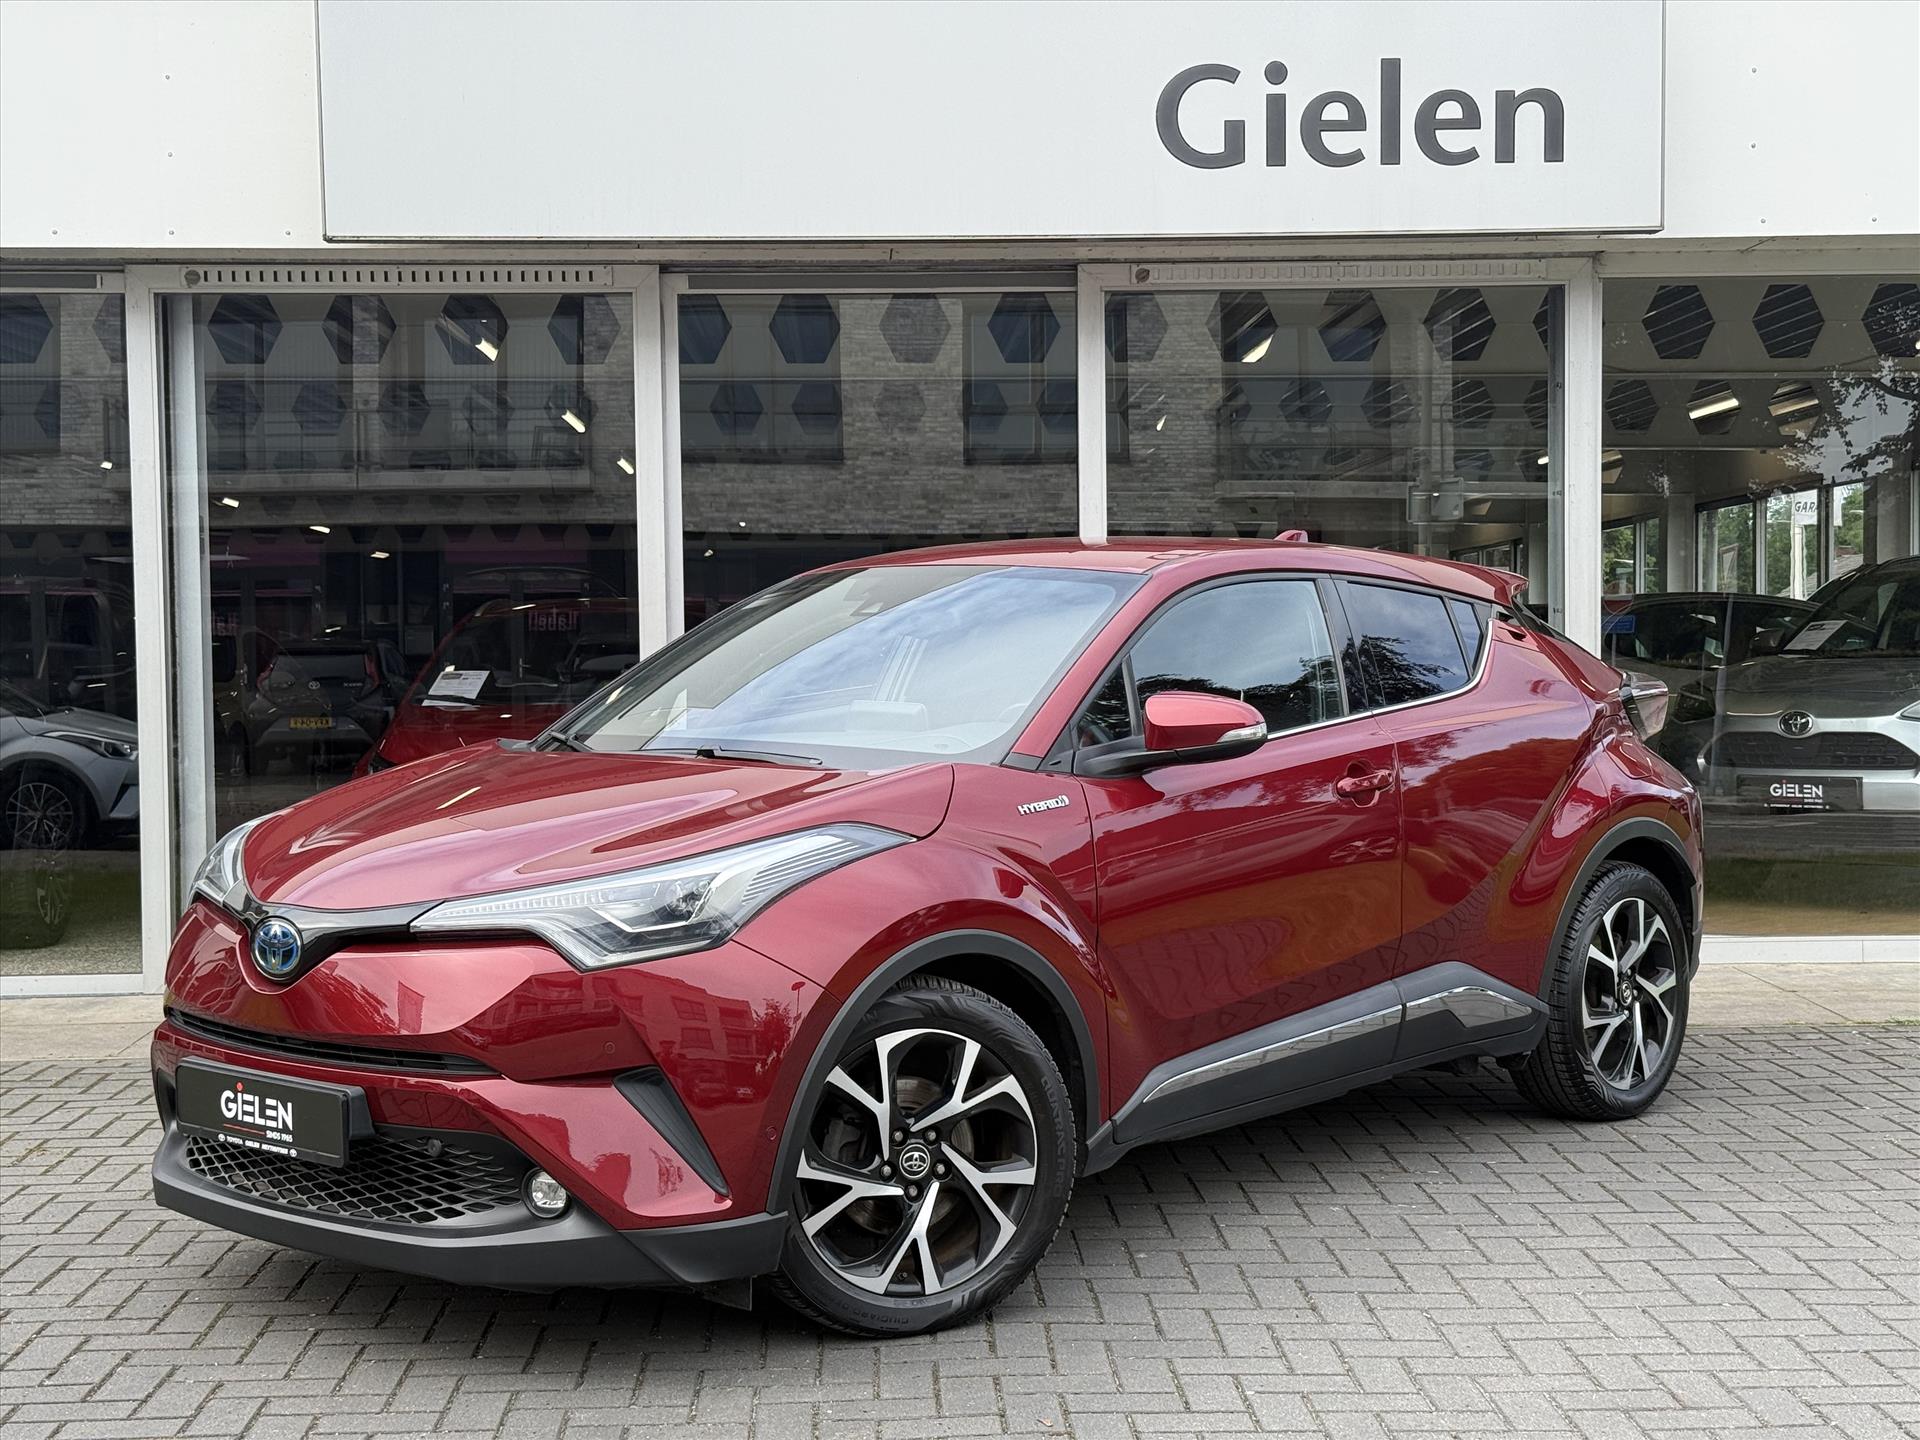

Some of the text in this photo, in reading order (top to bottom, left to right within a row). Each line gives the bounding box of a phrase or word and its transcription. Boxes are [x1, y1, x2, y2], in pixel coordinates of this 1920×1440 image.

[1156, 57, 1565, 169] Gielen
[1017, 797, 1061, 815] HYBRID
[226, 1136, 243, 1145] TOYOTA
